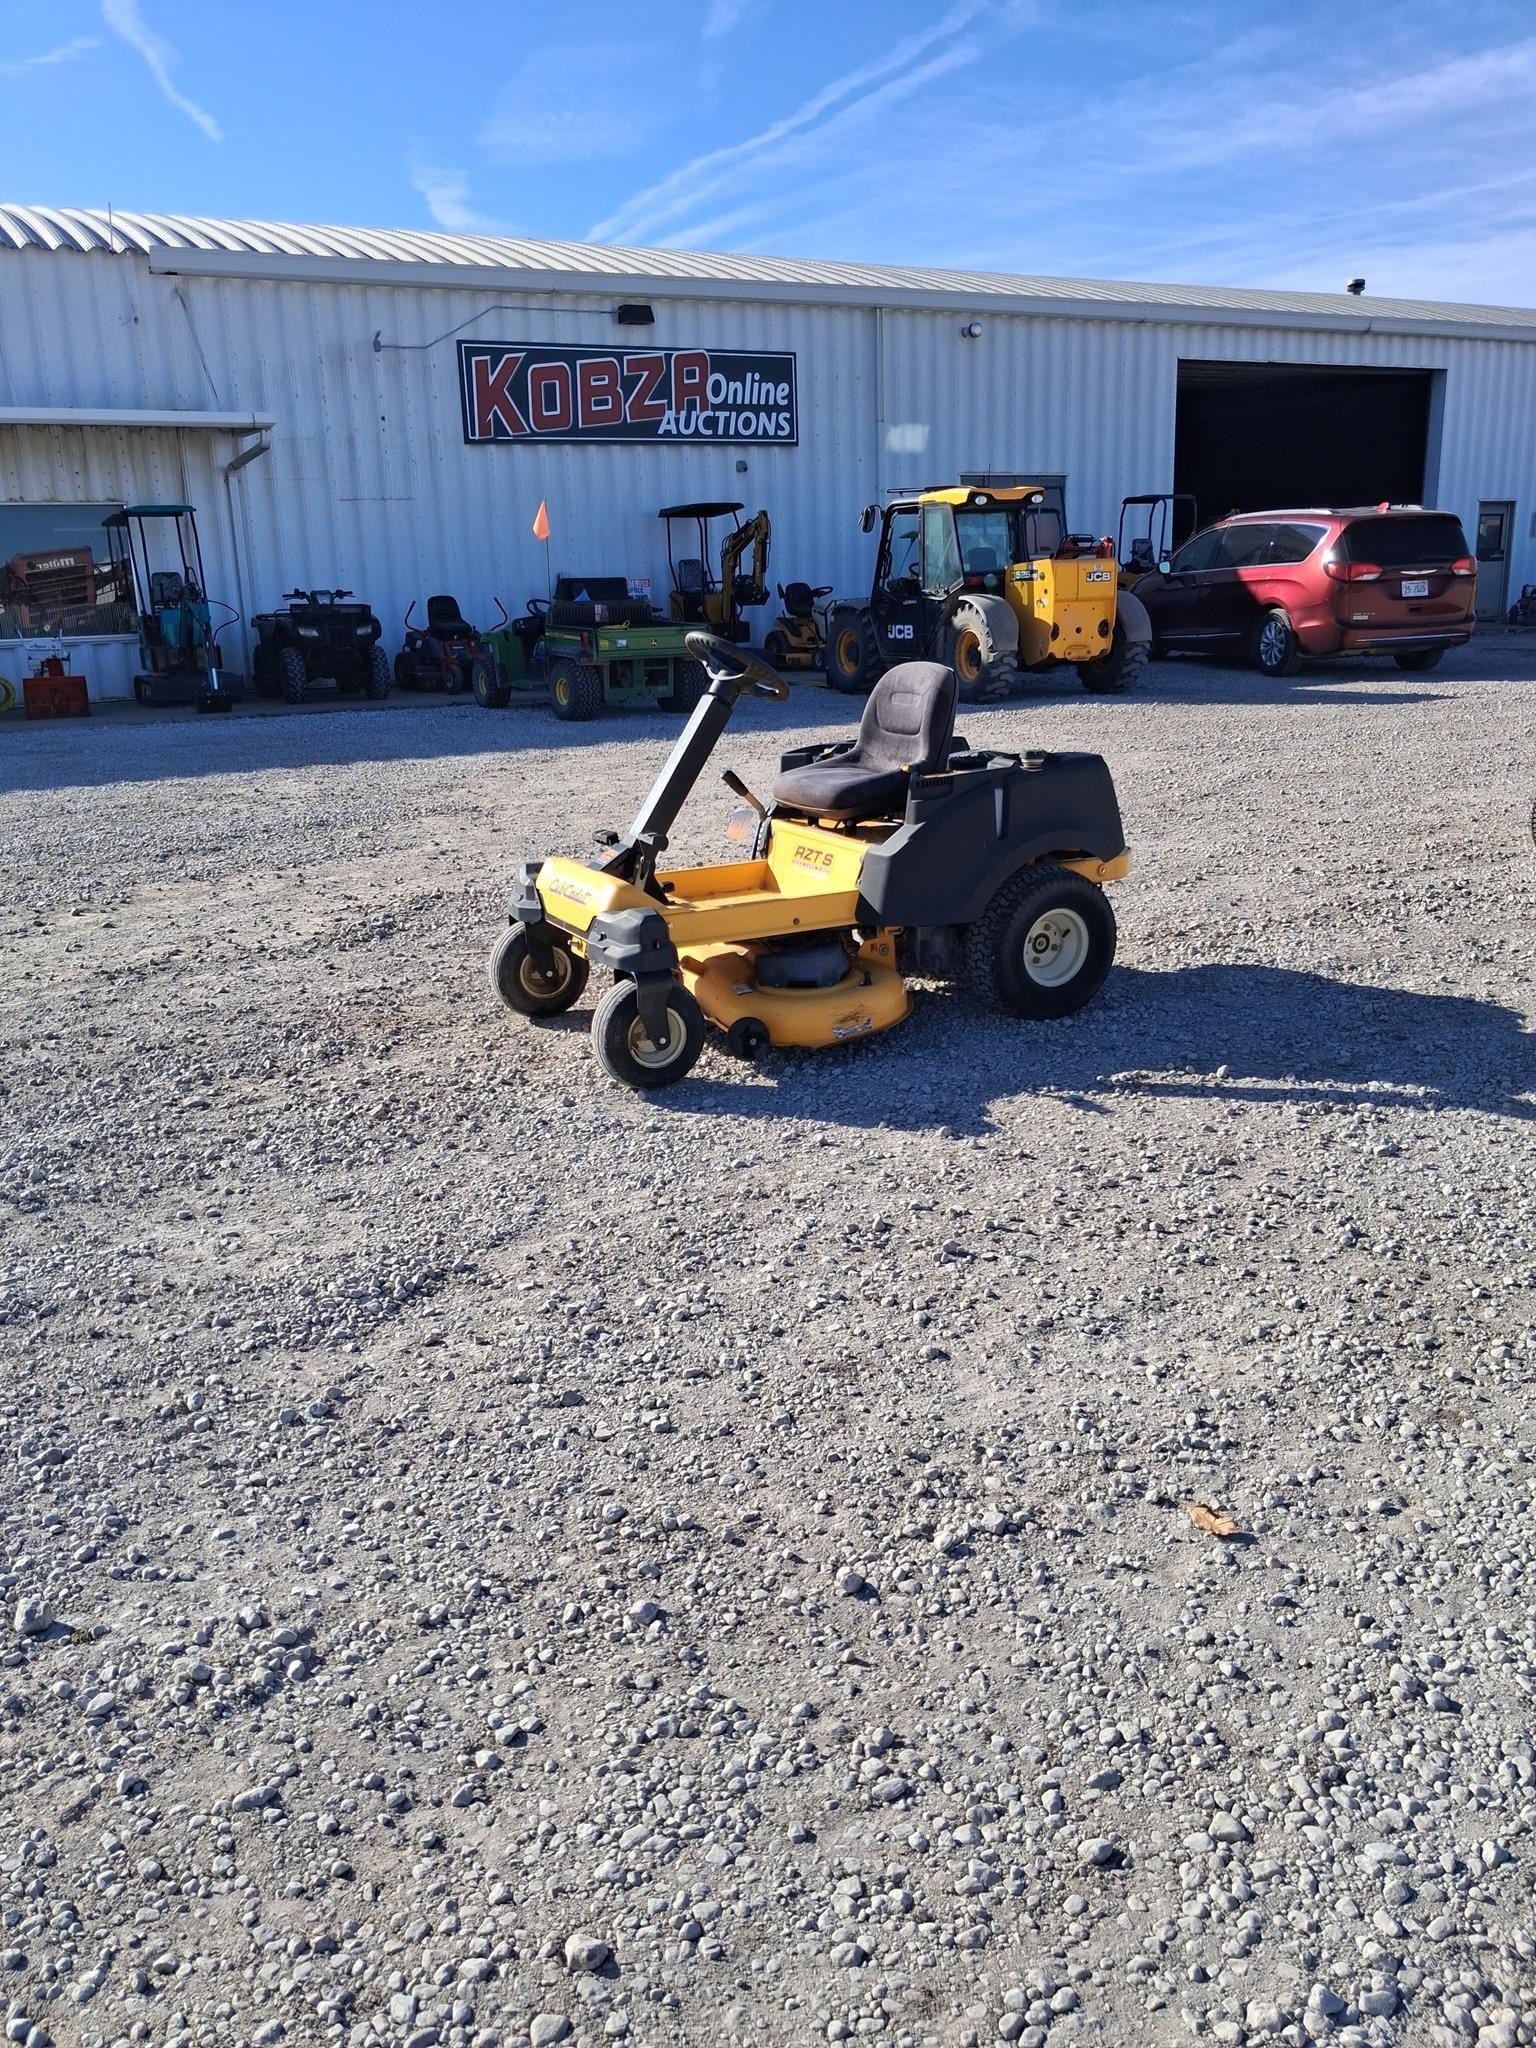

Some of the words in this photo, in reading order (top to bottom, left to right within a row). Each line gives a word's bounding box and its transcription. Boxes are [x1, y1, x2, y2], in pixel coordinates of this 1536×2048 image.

[472, 350, 711, 439] KOBZA
[706, 372, 790, 406] Online
[657, 410, 791, 436] AUCTIONS
[1086, 572, 1111, 582] JCB
[888, 624, 914, 639] JCB
[794, 845, 823, 863] RZT
[822, 853, 834, 867] S
[549, 878, 566, 895] Cub
[563, 884, 592, 906] Cadet
